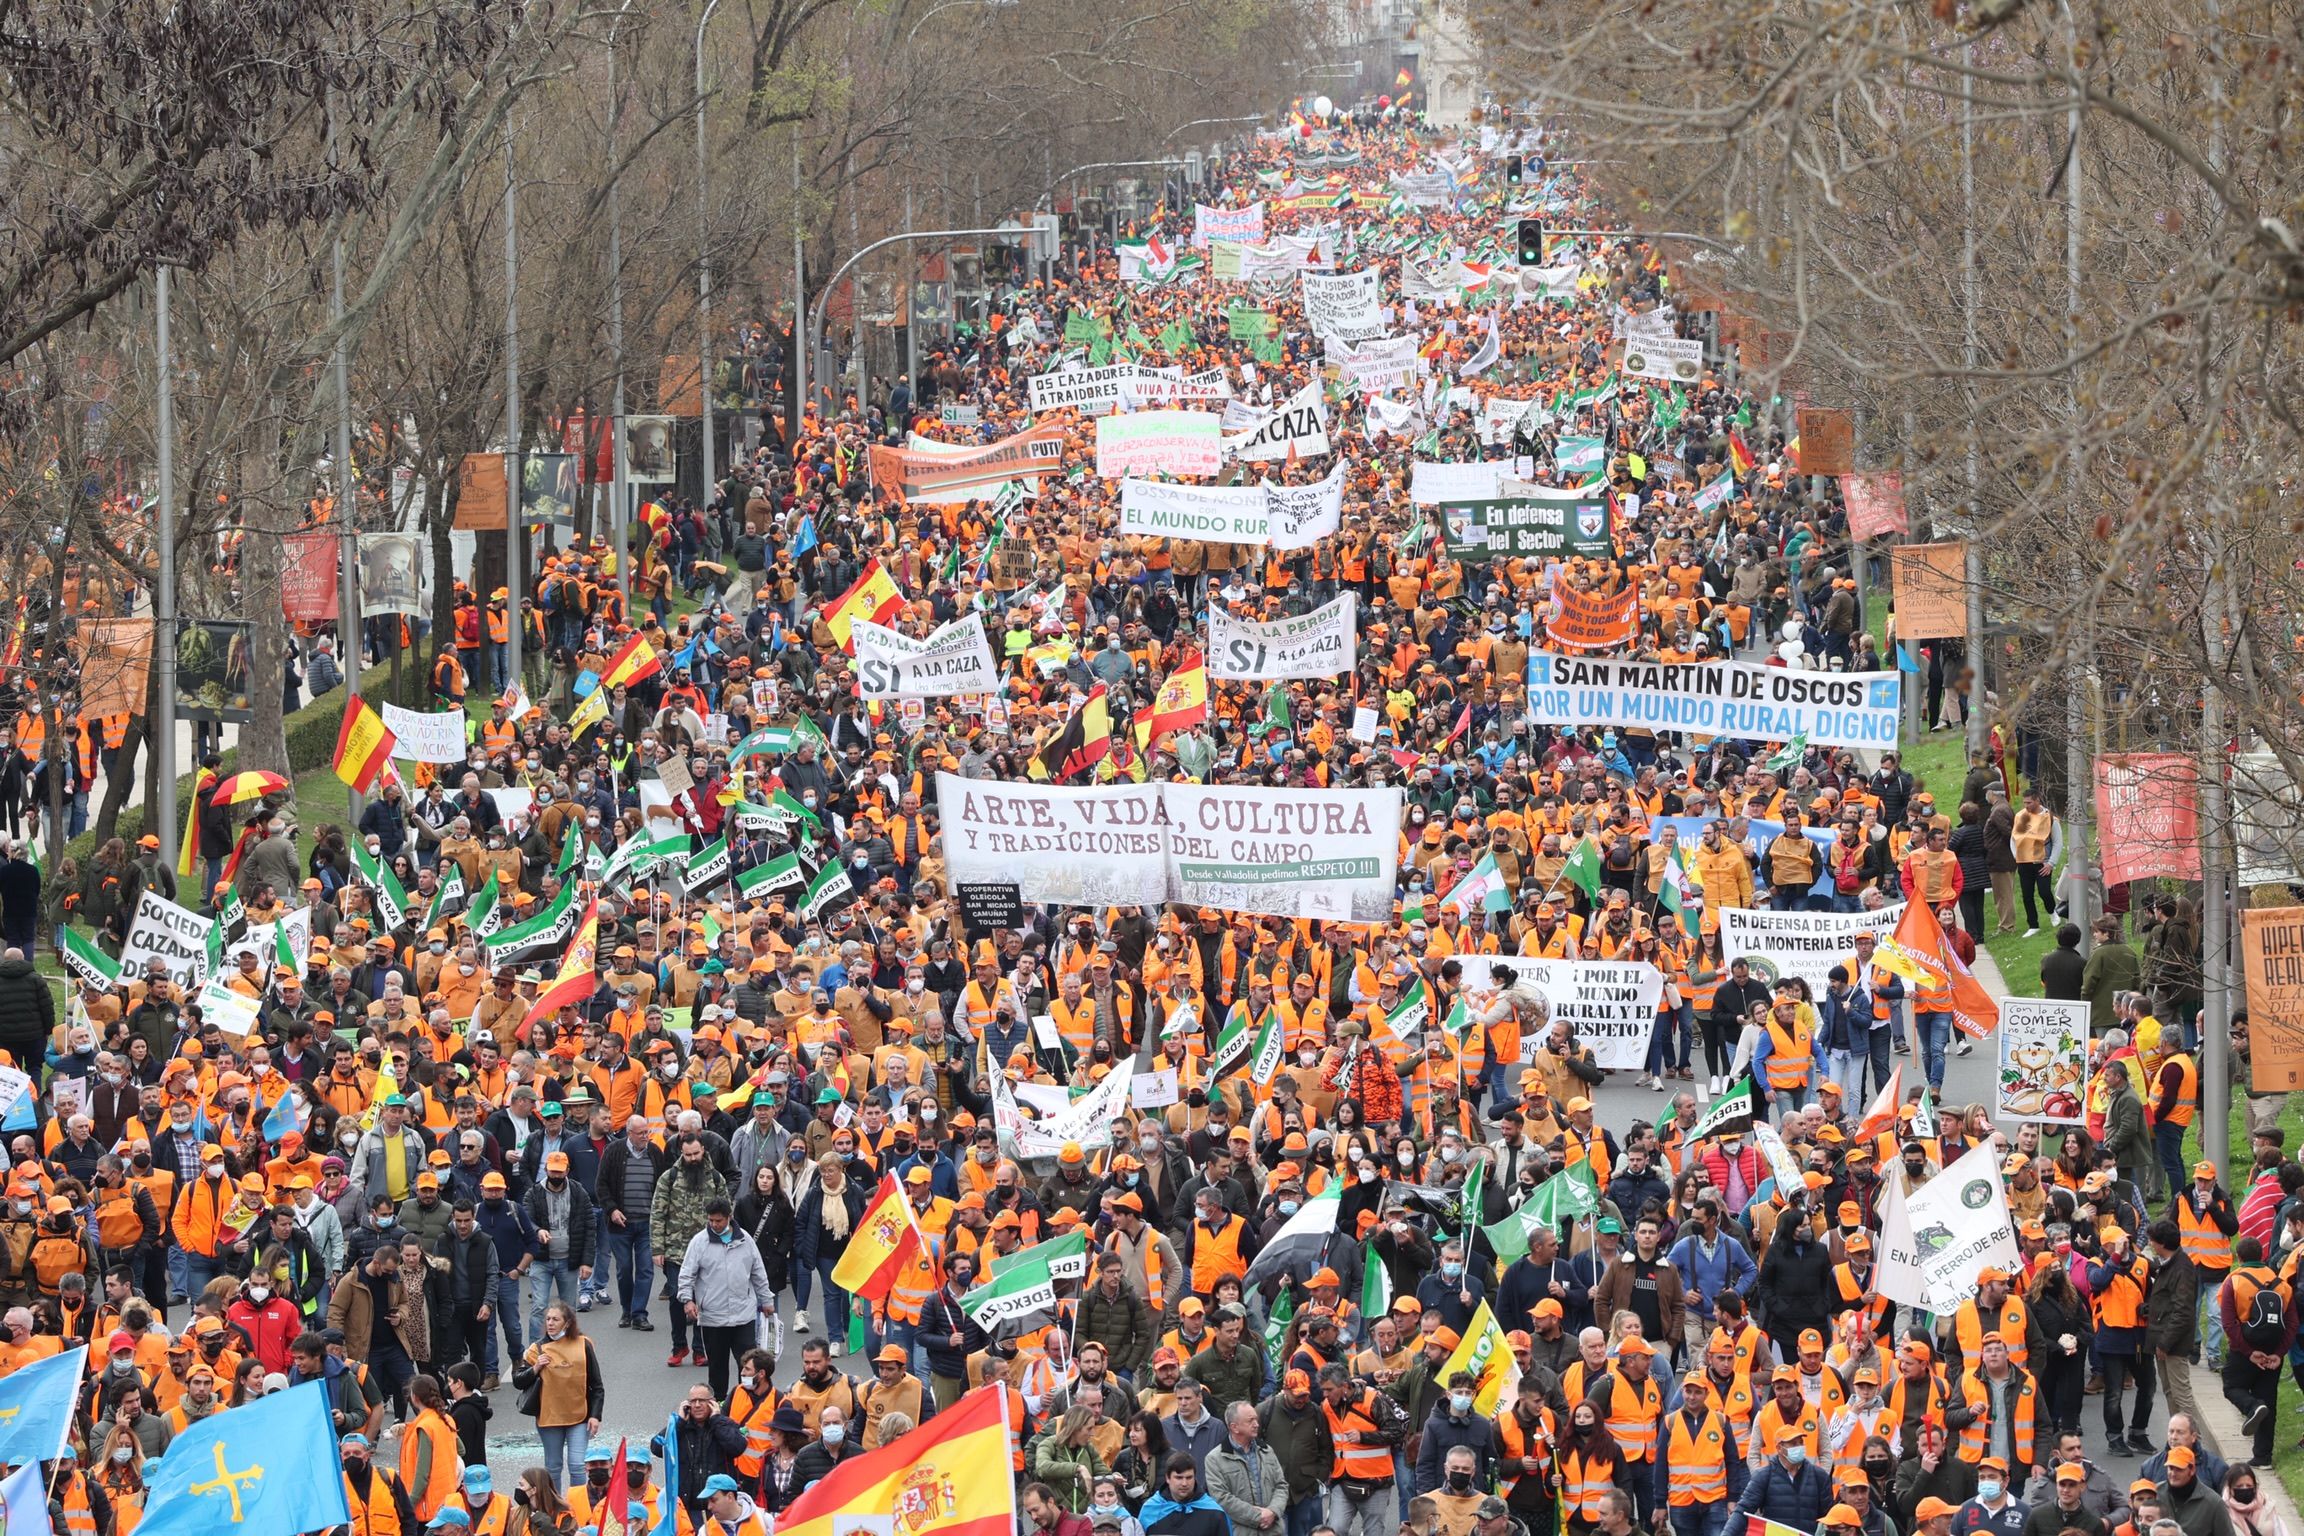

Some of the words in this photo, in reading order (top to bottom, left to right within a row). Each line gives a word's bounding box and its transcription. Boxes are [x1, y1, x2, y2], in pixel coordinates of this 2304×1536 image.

[1324, 279, 1355, 292] ISIDRO
[1638, 336, 1659, 348] DEFENSA
[1678, 342, 1699, 350] REHALA
[1669, 350, 1697, 359] ESPAÑOLA
[1035, 378, 1053, 391] OS
[1058, 365, 1133, 388] CAZADORES
[1039, 394, 1047, 406] A
[1048, 383, 1119, 404] TRAIDORES
[1136, 384, 1163, 395] VIVA
[1169, 384, 1178, 395] A
[1181, 384, 1218, 395] CAZA
[1269, 406, 1322, 441] CAZA
[1134, 485, 1182, 501] OSSA
[1186, 491, 1208, 502] DE
[1198, 507, 1217, 515] con
[1486, 506, 1503, 527] En
[1508, 505, 1564, 527] defensa
[1126, 508, 1144, 525] EL
[1151, 510, 1227, 532] MUNDO
[1285, 522, 1297, 535] LA
[1486, 530, 1511, 551] del
[1517, 529, 1564, 550] Sector
[1001, 566, 1012, 578] DEL
[1592, 604, 1599, 612] A
[1601, 602, 1613, 612] MI
[1261, 627, 1281, 638] LA
[1287, 604, 1342, 635] PERDIZ
[1564, 607, 1582, 621] NOS
[1586, 612, 1619, 625] TOCAIS
[1566, 622, 1584, 635] LOS
[866, 629, 892, 649] C.D.
[1278, 650, 1287, 661] A
[1315, 658, 1325, 669] de
[862, 653, 901, 693] SÍ
[913, 665, 922, 678] A
[926, 661, 943, 677] LA
[947, 655, 982, 674] CAZA
[932, 680, 954, 691] forma
[956, 679, 965, 689] de
[966, 675, 982, 687] vida
[1554, 657, 1610, 686] SAN
[1619, 664, 1722, 696] MARTIN
[1731, 670, 1765, 699] DE
[1772, 675, 1863, 706] OSCOS
[1529, 690, 1571, 717] POR
[1579, 690, 1614, 718] UN
[1622, 692, 1714, 727] MUNDO
[1721, 702, 1805, 735] RURAL
[1816, 710, 1896, 742] DIGNO
[962, 791, 1068, 833] ARTE,
[1074, 794, 1186, 833] VIDA,
[1198, 796, 1372, 835] CULTURA
[964, 829, 979, 850] Y
[989, 831, 1161, 854] TRADICIONES
[1172, 834, 1219, 859] DEL
[1231, 839, 1314, 864] CAMPO
[1186, 869, 1213, 880] Desde
[1215, 870, 1259, 880] Valladolid
[1261, 869, 1299, 883] pedimos
[1301, 861, 1356, 878] RESPETO
[2139, 864, 2177, 873] MADRID
[972, 910, 1008, 918] CAMUÑAS
[1730, 913, 1747, 929] EN
[1751, 915, 1810, 932] DEFENSA
[1815, 919, 1831, 931] DE
[1835, 919, 1851, 931] LA
[1733, 935, 1741, 949] Y
[1745, 935, 1761, 950] LA
[1765, 934, 1833, 951] MONTERÍA
[1584, 970, 1618, 984] POR
[1628, 970, 1644, 985] EL
[1576, 987, 1638, 1002] MUNDO
[2268, 988, 2287, 1000] EL
[1556, 1002, 1616, 1019] RURAL
[1620, 1005, 1633, 1019] Y
[1635, 1005, 1656, 1020] EL
[2054, 1005, 2067, 1016] de
[2270, 1000, 2299, 1014] DEL
[2008, 1014, 2073, 1028] COMER
[1572, 1023, 1639, 1037] ESPETO
[1644, 1024, 1649, 1036] !
[2024, 1025, 2036, 1034] se
[2040, 1024, 2071, 1039] juega
[1890, 1249, 1907, 1263] EN
[1935, 1248, 1973, 1281] PERRO
[1974, 1237, 1990, 1253] DE
[1945, 1281, 1954, 1291] Y
[1968, 1508, 1980, 1526] 2
